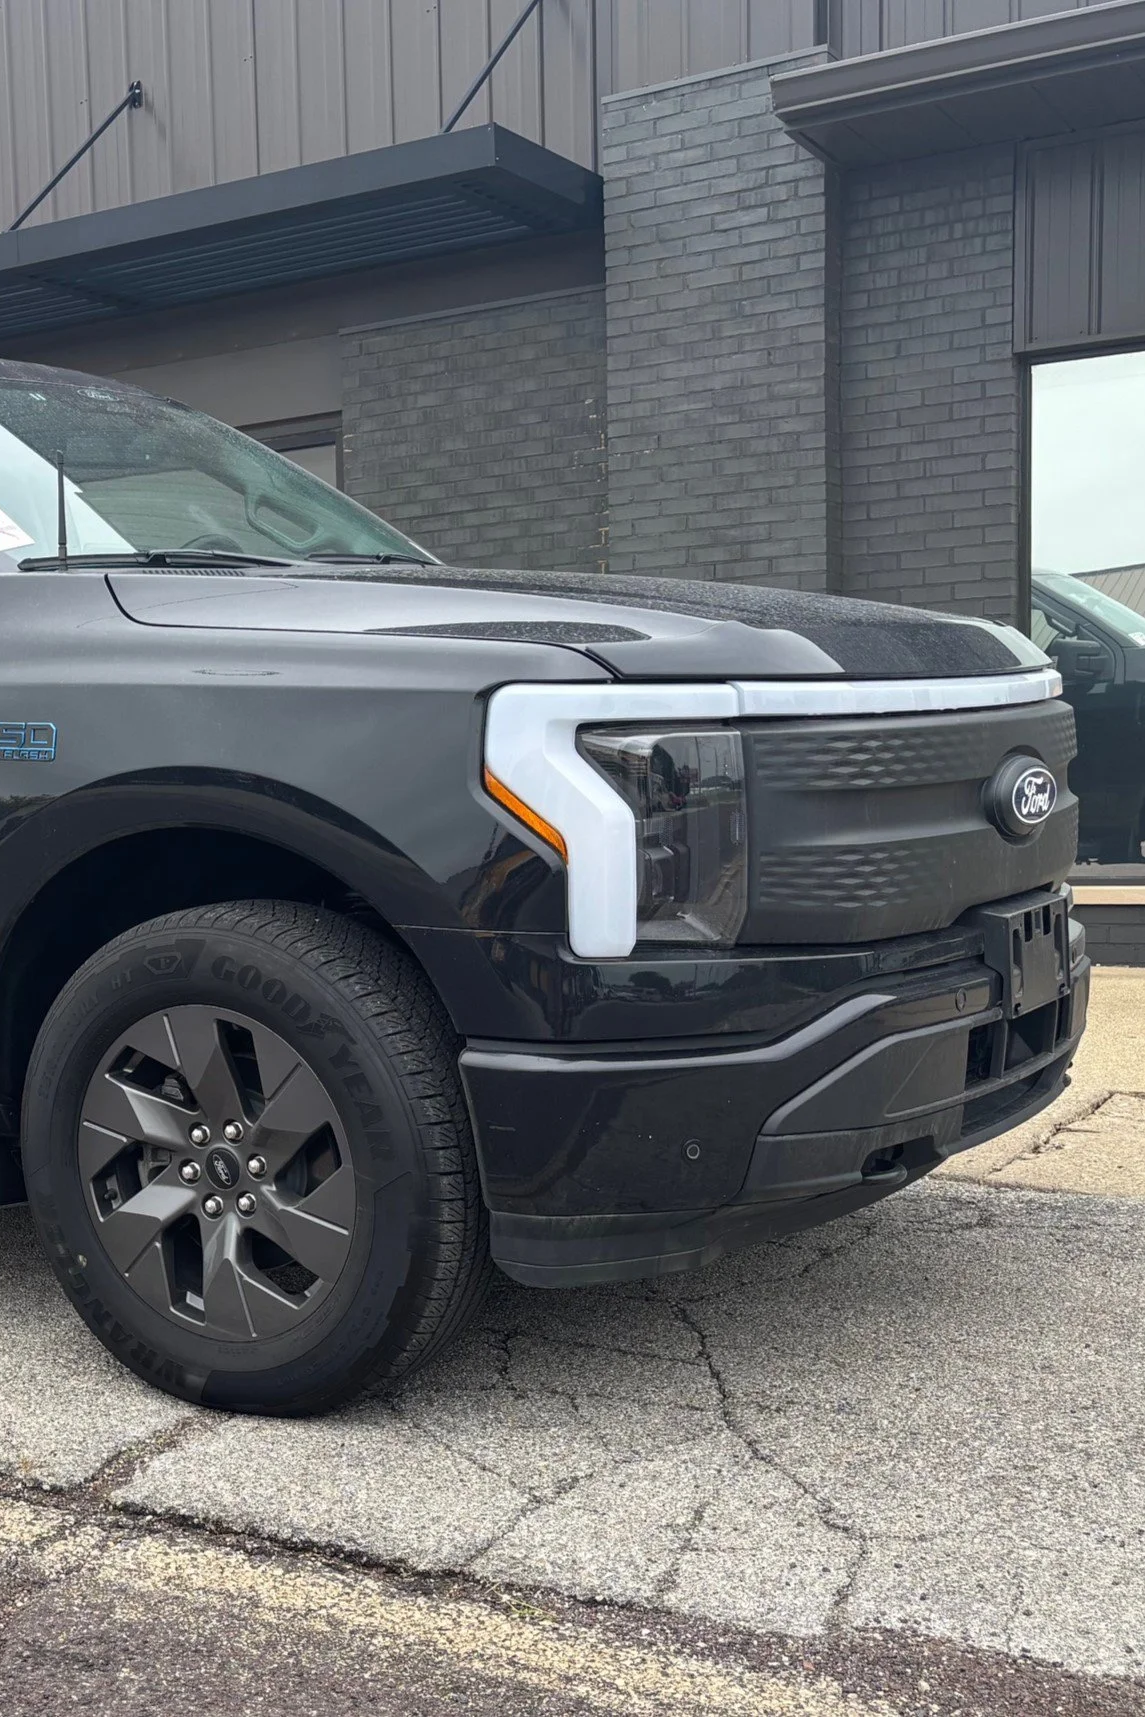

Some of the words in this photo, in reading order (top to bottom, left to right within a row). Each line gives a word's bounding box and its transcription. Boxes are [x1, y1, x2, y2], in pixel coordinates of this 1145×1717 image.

[2, 750, 50, 760] FLASH
[1020, 776, 1052, 816] Ford
[211, 955, 396, 1163] GOODYEAR
